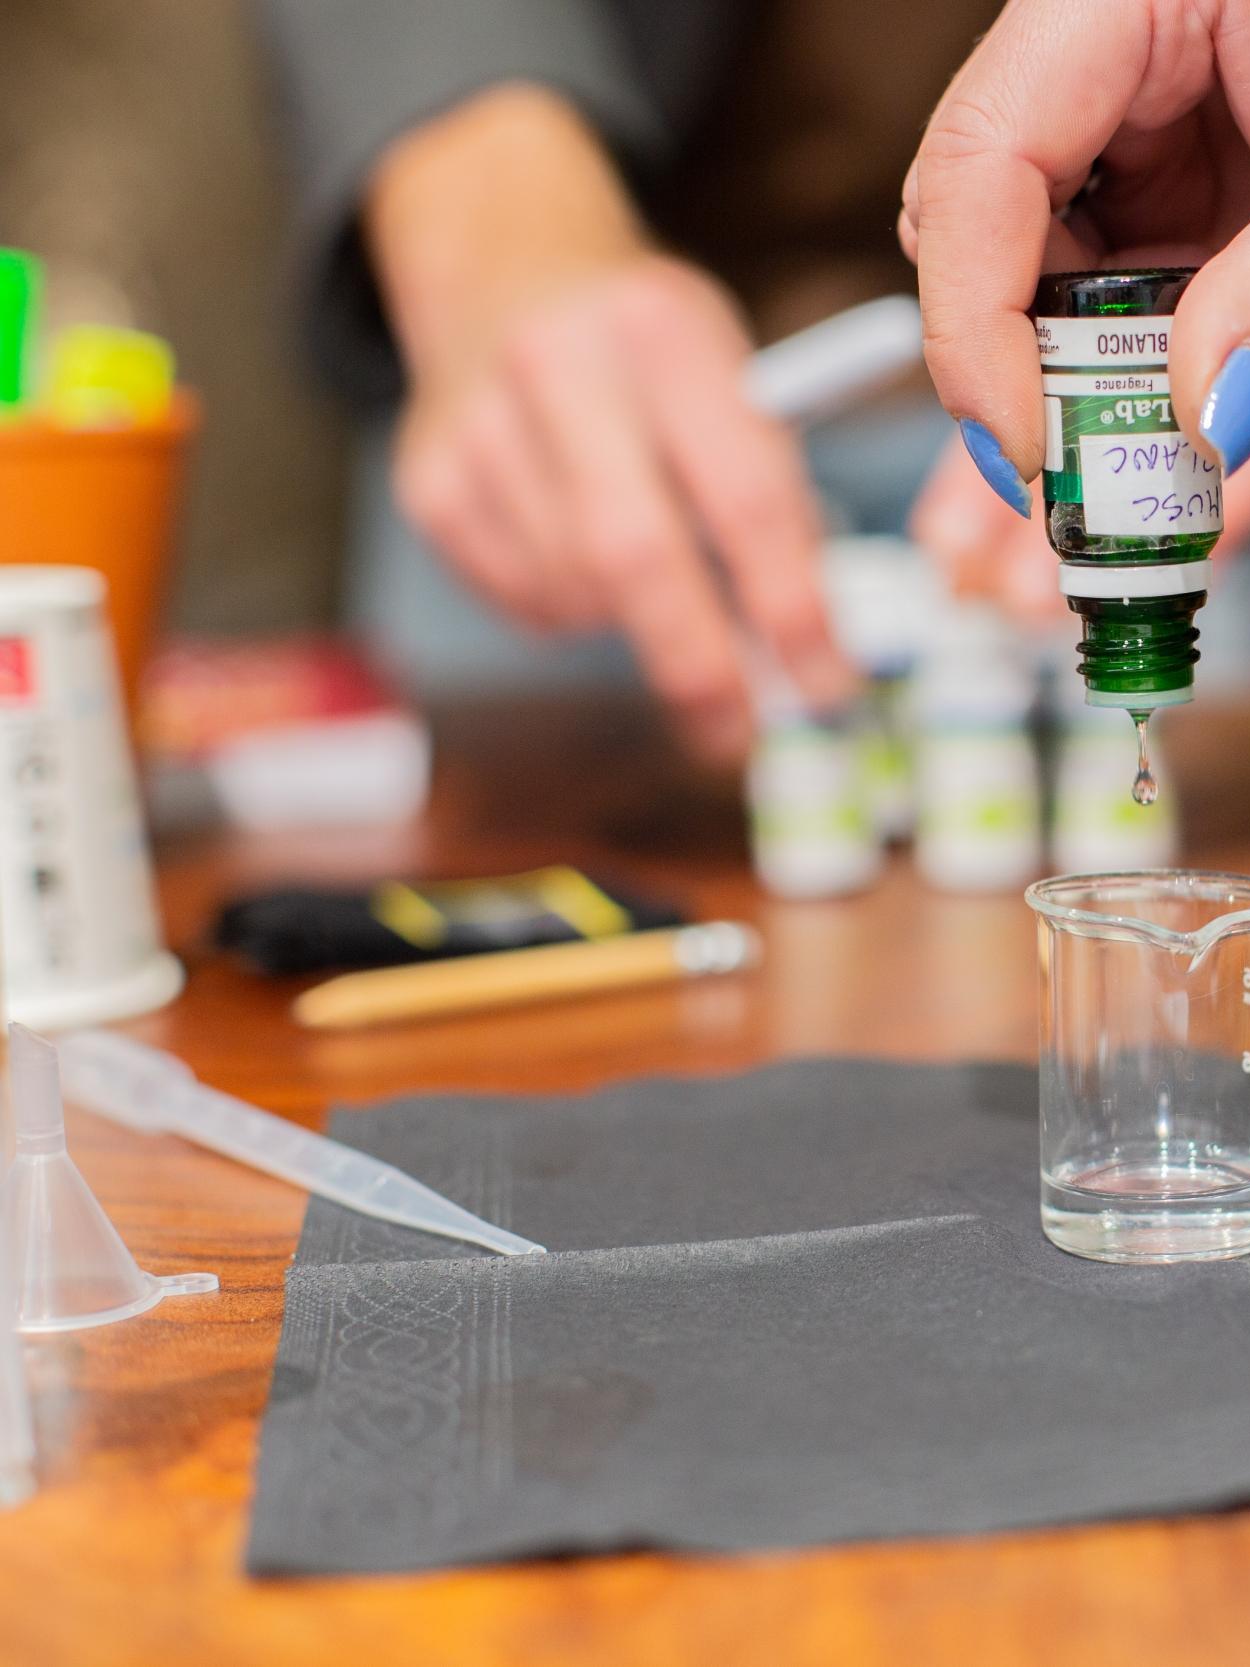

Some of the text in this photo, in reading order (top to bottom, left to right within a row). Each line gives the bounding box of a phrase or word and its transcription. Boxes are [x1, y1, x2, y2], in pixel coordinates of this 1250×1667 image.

[1097, 333, 1168, 354] BLANCO
[1095, 377, 1153, 391] Fragrance
[1132, 485, 1220, 522] MUSC
